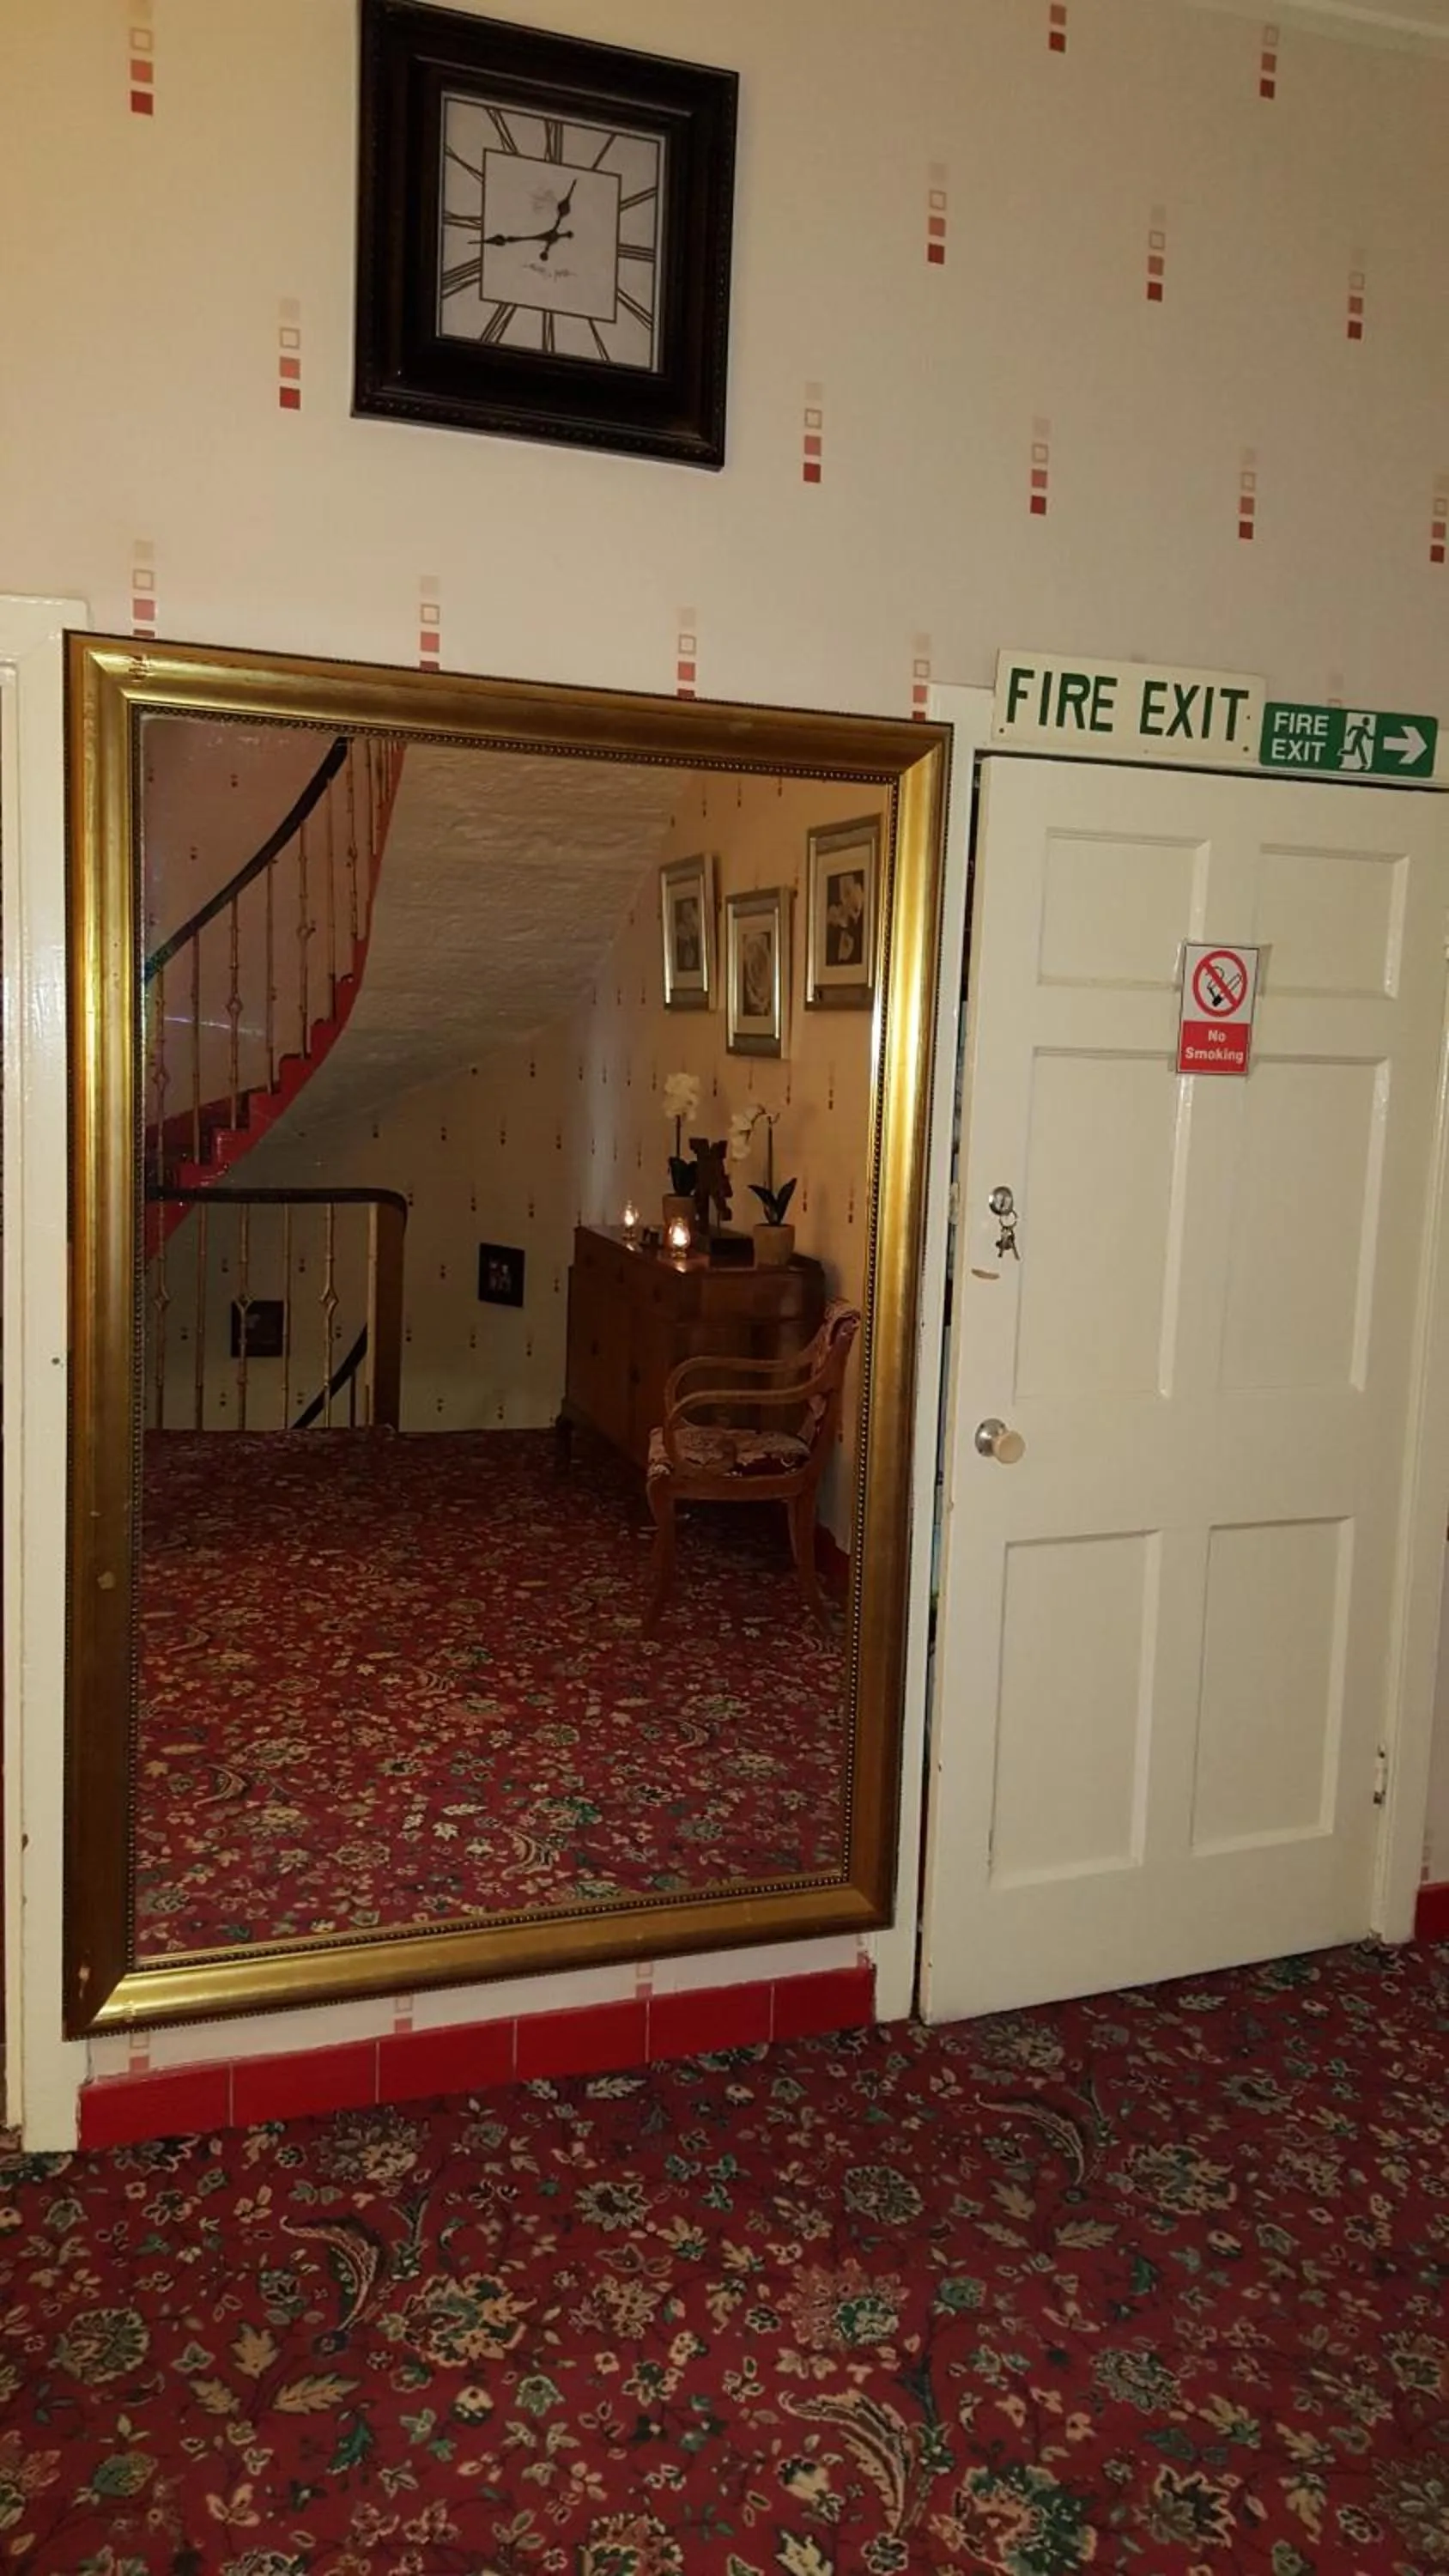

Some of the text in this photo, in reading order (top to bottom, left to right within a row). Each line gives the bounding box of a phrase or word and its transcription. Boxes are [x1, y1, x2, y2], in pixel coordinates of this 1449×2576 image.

[1006, 667, 1249, 742] FIRE EXIT
[1273, 711, 1330, 738] FIRE
[1270, 739, 1326, 763] EXIT
[1208, 1030, 1226, 1042] No
[1185, 1047, 1244, 1064] Smoking
